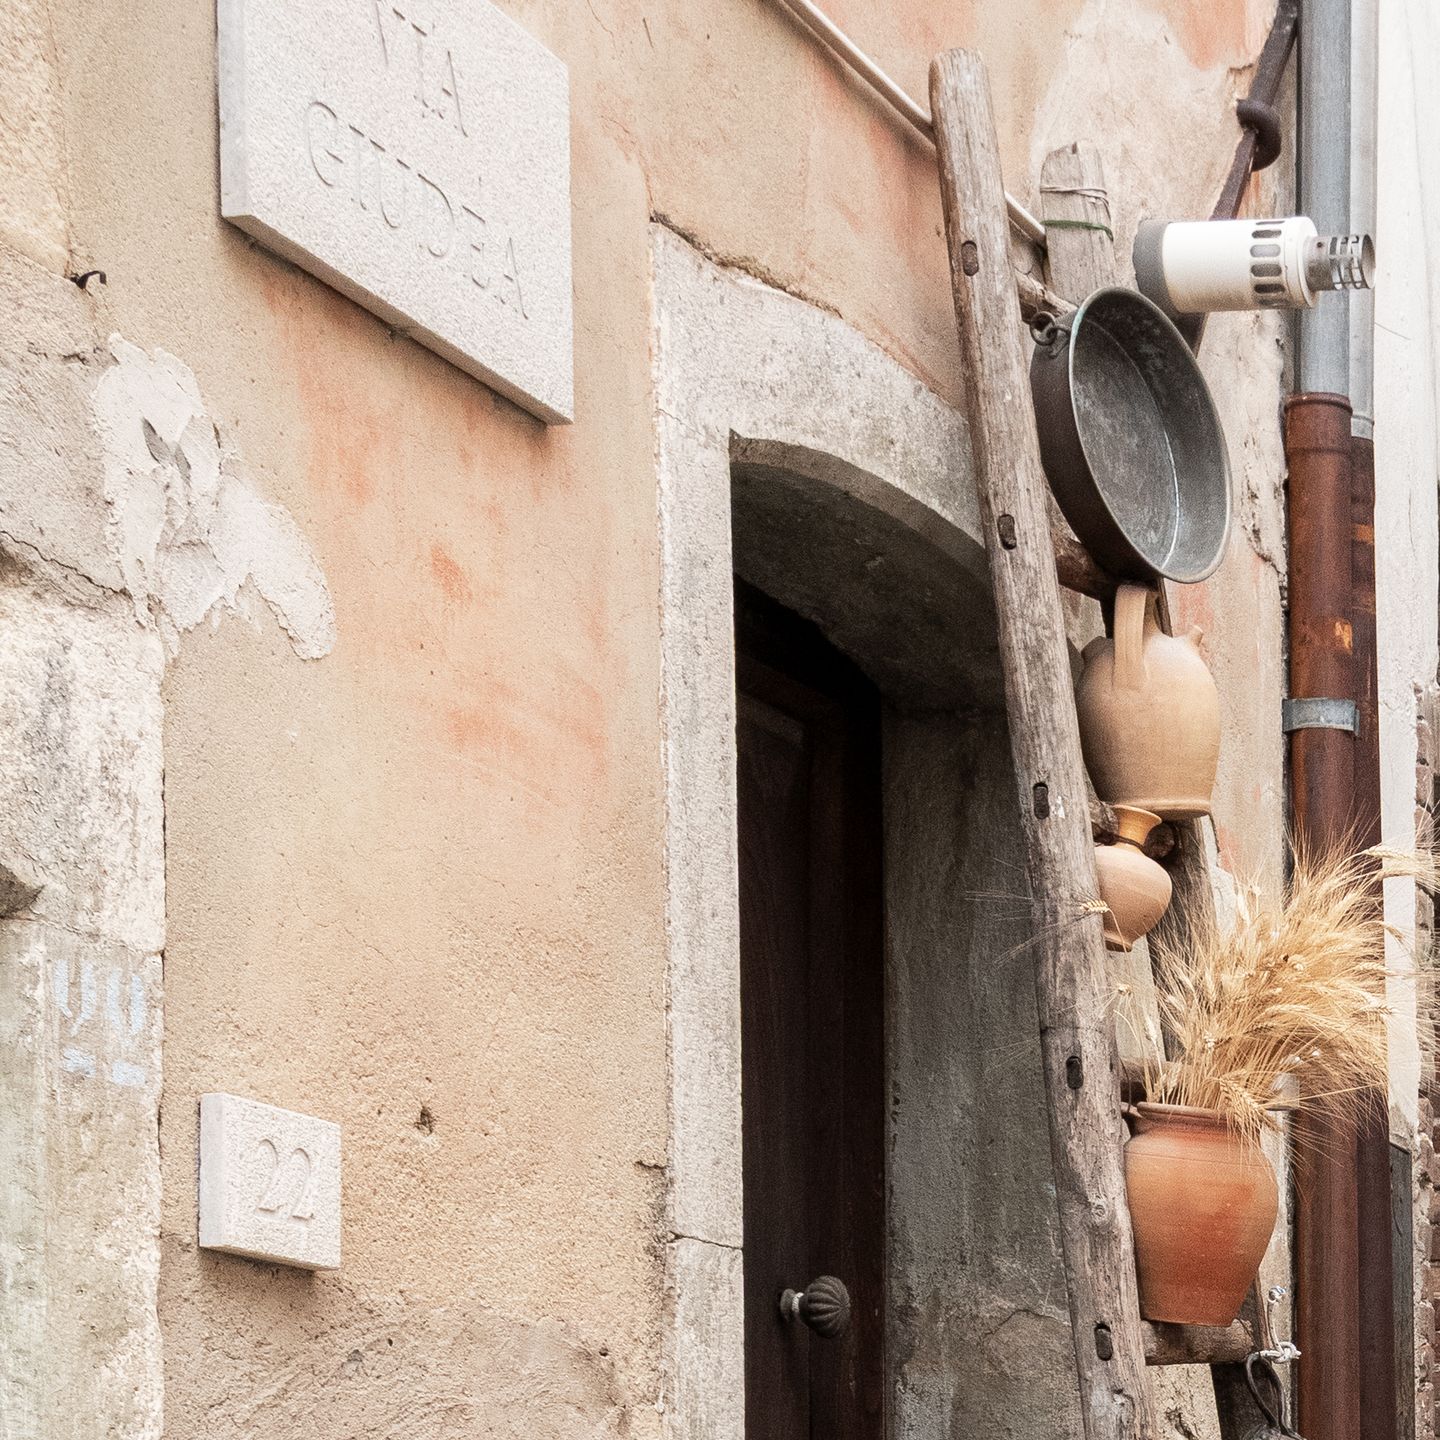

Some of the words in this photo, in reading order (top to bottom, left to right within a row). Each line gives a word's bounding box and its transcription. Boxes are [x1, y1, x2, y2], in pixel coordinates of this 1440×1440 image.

[373, 0, 469, 138] VIA
[306, 100, 530, 321] GIUDEA
[255, 1137, 316, 1224] 22
